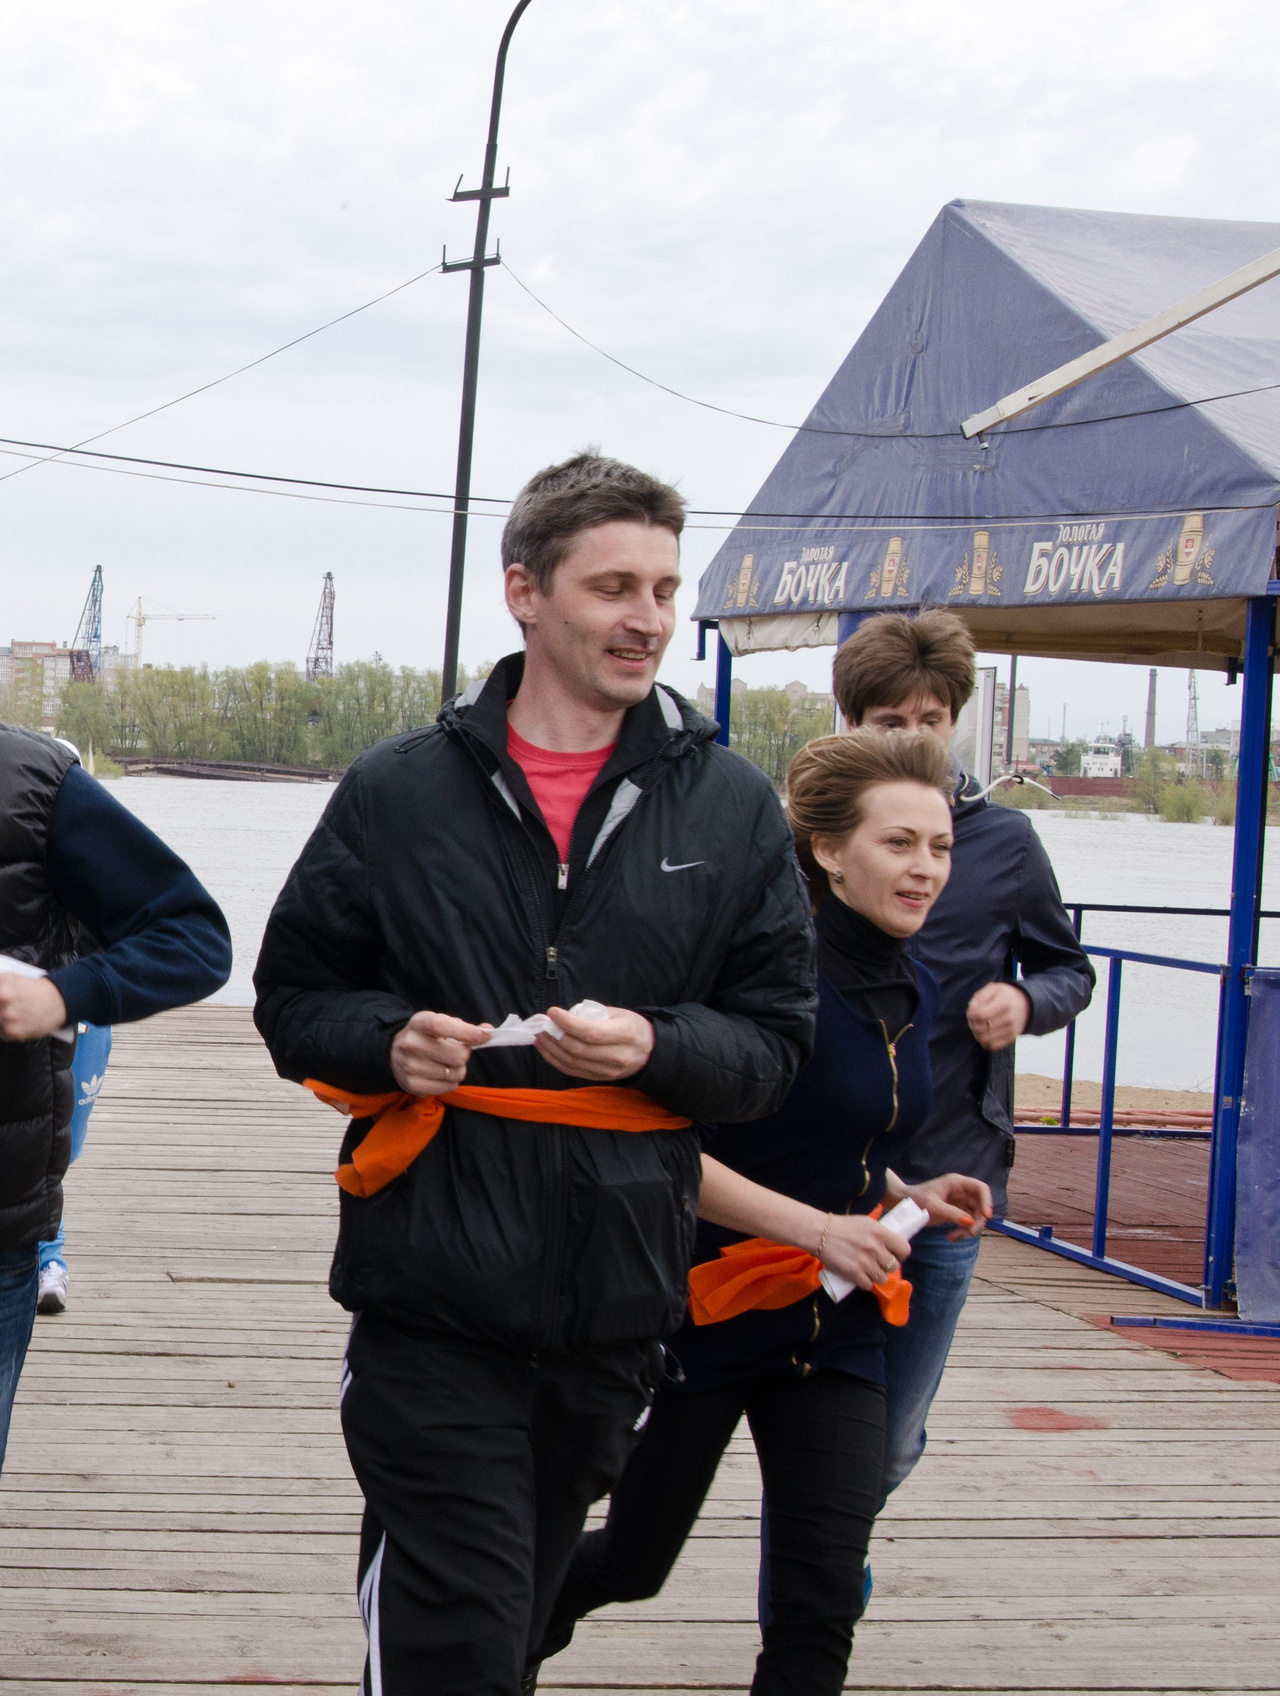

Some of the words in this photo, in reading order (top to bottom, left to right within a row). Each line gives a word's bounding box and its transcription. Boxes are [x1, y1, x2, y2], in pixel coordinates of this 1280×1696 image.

[1056, 523, 1106, 545] ЗОЛОТАЯ
[800, 546, 835, 562] ЗОЛОТАЯ
[1023, 542, 1125, 598] БОЧКА
[773, 561, 849, 607] БОЧКА
